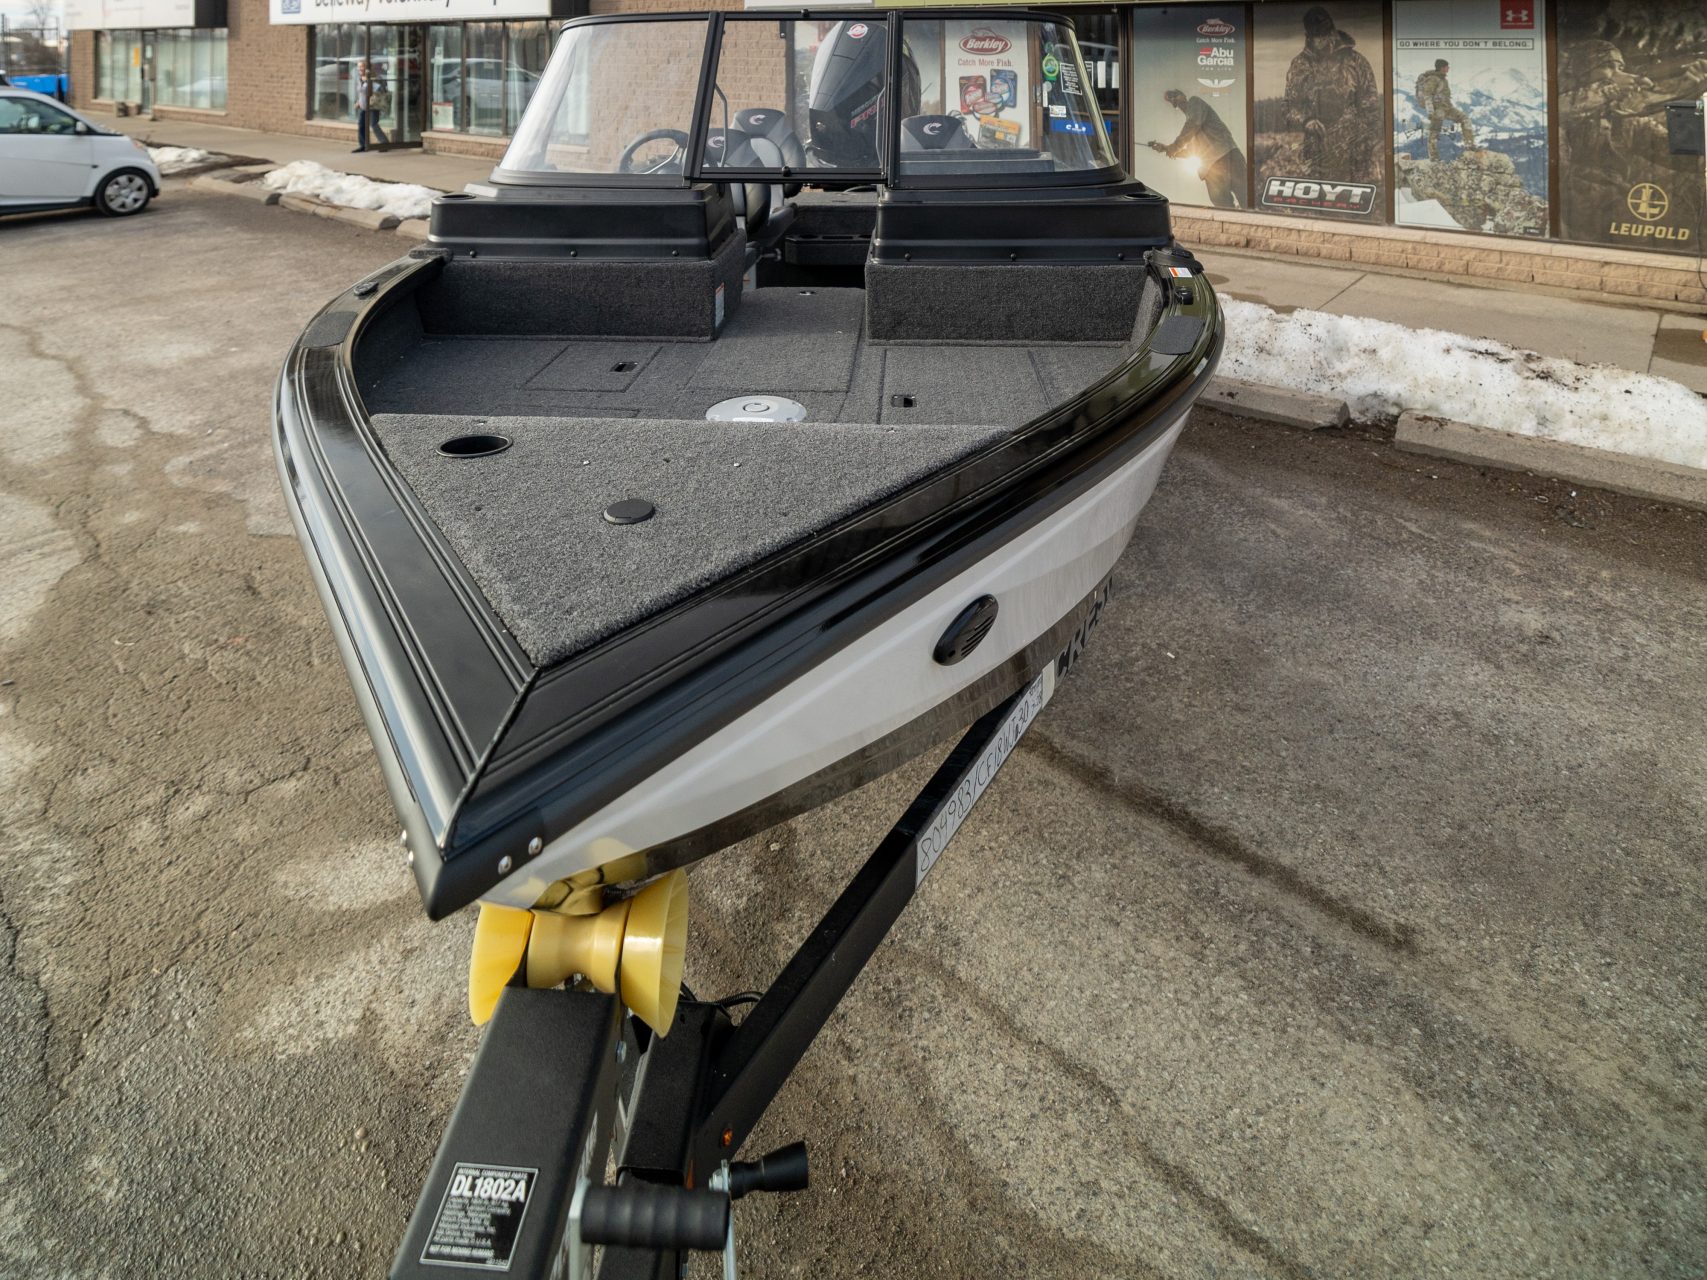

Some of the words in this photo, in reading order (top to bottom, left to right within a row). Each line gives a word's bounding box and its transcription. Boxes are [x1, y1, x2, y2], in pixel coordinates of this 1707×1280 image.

[965, 37, 1007, 51] Berkley
[1399, 40, 1411, 48] GO
[1412, 40, 1441, 48] WHERE
[1443, 40, 1460, 48] YOU
[1211, 47, 1234, 58] Abu
[957, 58, 977, 67] Catch
[978, 58, 995, 67] More
[1197, 55, 1235, 66] Garcia
[1267, 180, 1371, 203] HOYT
[1609, 222, 1690, 240] LEUPOLD
[450, 1174, 527, 1203] DL1802A
